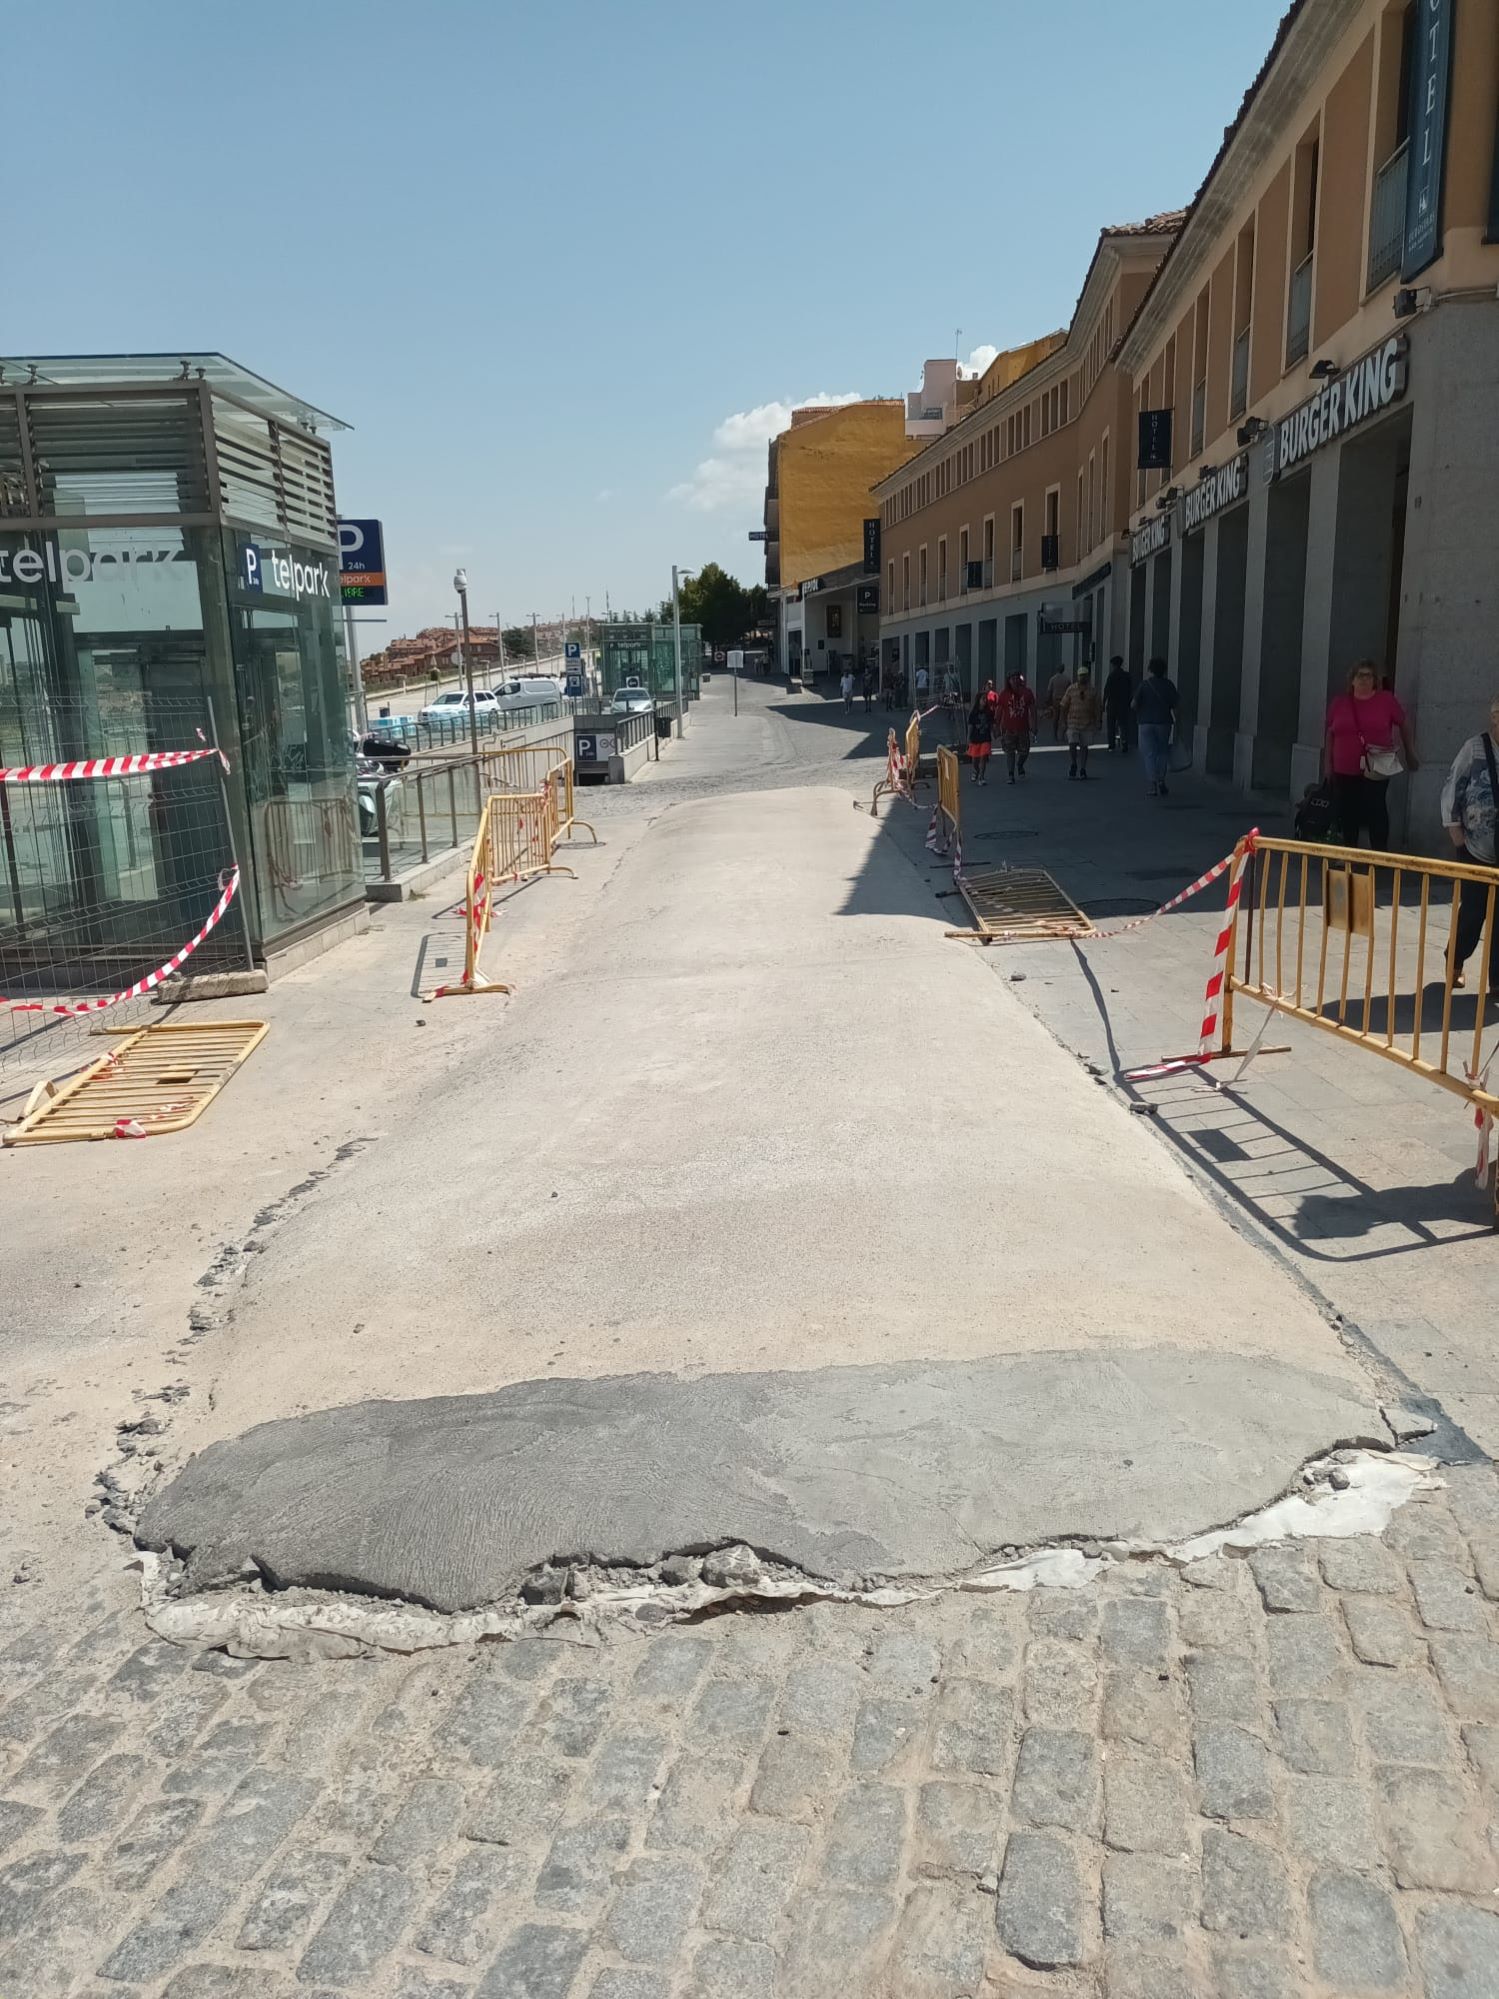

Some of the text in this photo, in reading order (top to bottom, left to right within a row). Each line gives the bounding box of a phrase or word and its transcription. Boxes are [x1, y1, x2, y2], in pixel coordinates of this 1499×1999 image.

[1422, 0, 1439, 166] TEL
[1280, 337, 1397, 469] BURGER KING
[1185, 456, 1241, 529] BURGER KING
[246, 548, 257, 585] P
[337, 524, 364, 570] P
[348, 562, 365, 570] 24h
[272, 549, 330, 602] telpark
[567, 645, 577, 656] P
[579, 740, 591, 756] P
